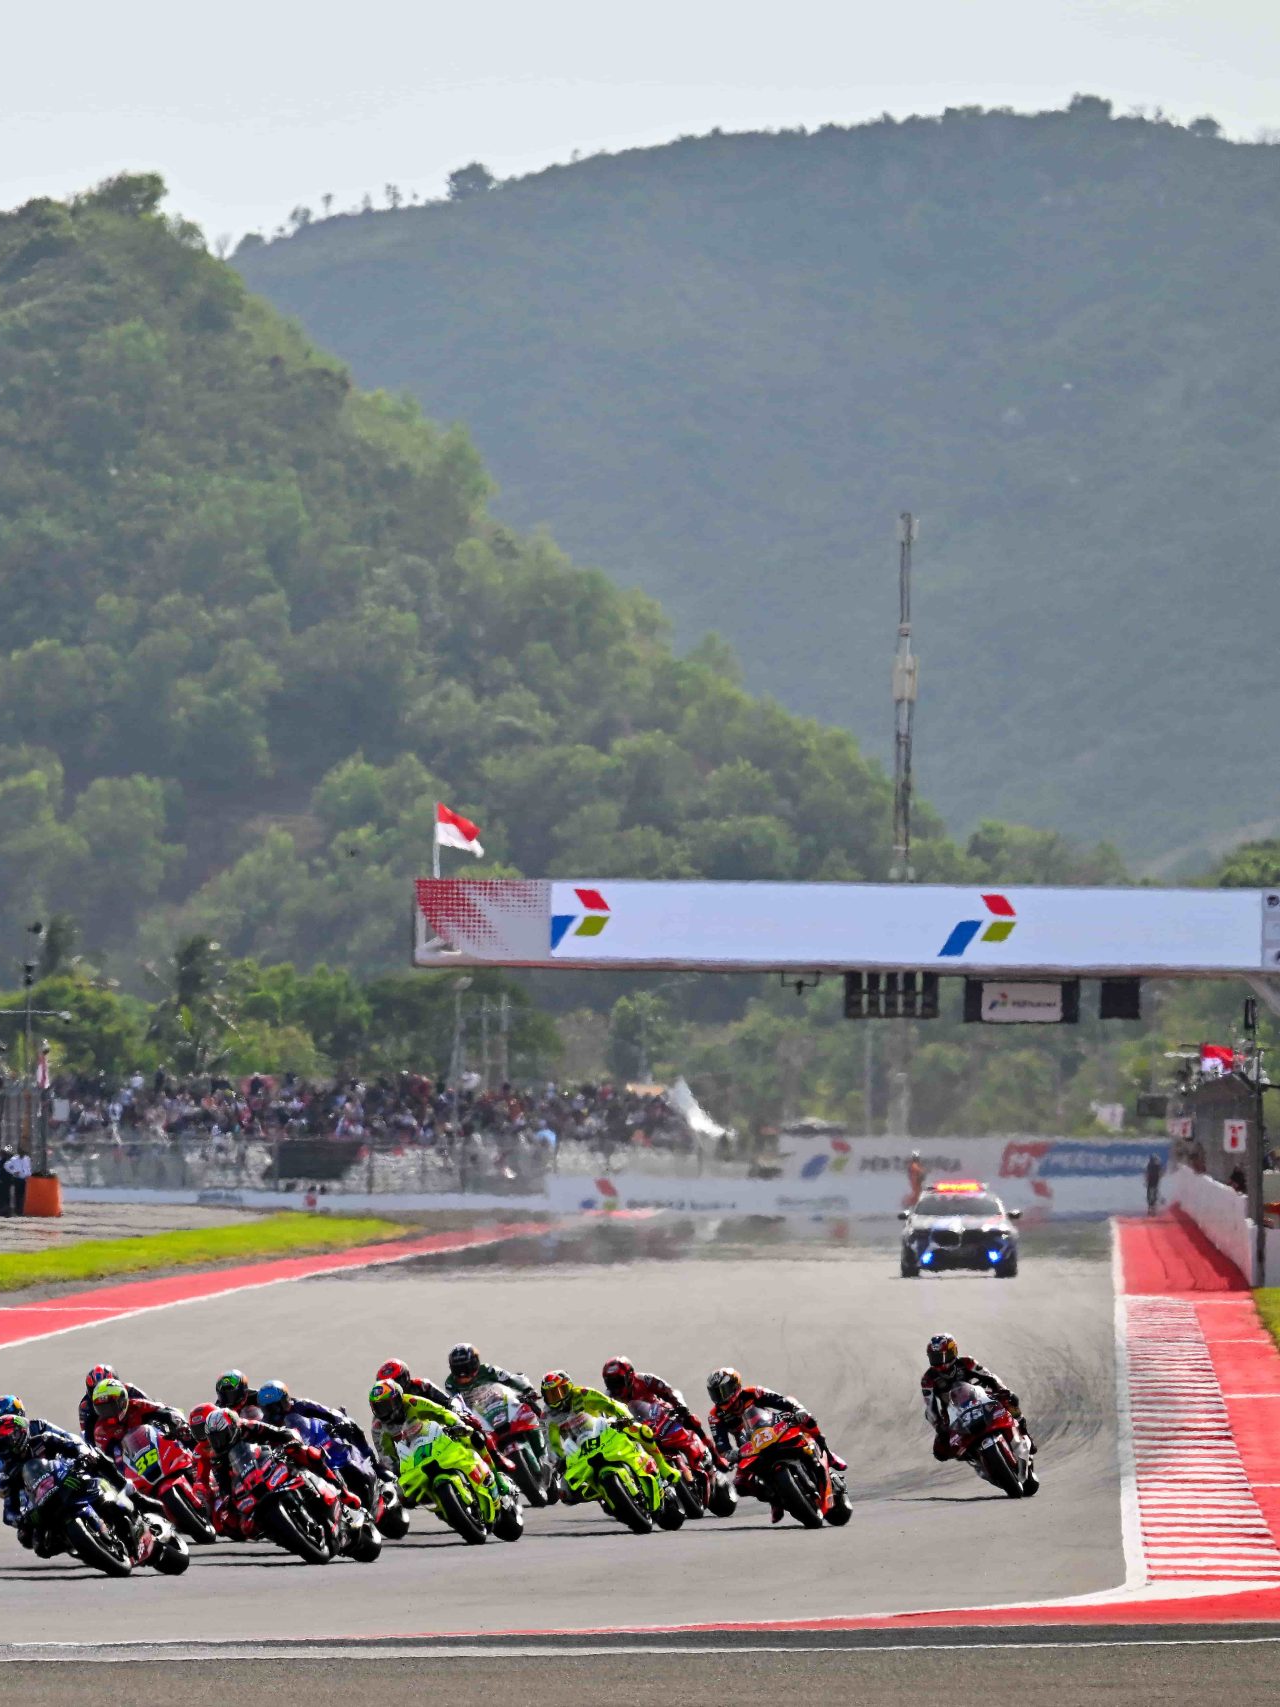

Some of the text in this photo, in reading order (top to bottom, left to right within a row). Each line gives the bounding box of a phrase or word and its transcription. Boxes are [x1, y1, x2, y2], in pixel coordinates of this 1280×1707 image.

[579, 1435, 600, 1458] 49
[753, 1428, 773, 1448] 23
[135, 1448, 158, 1476] 36
